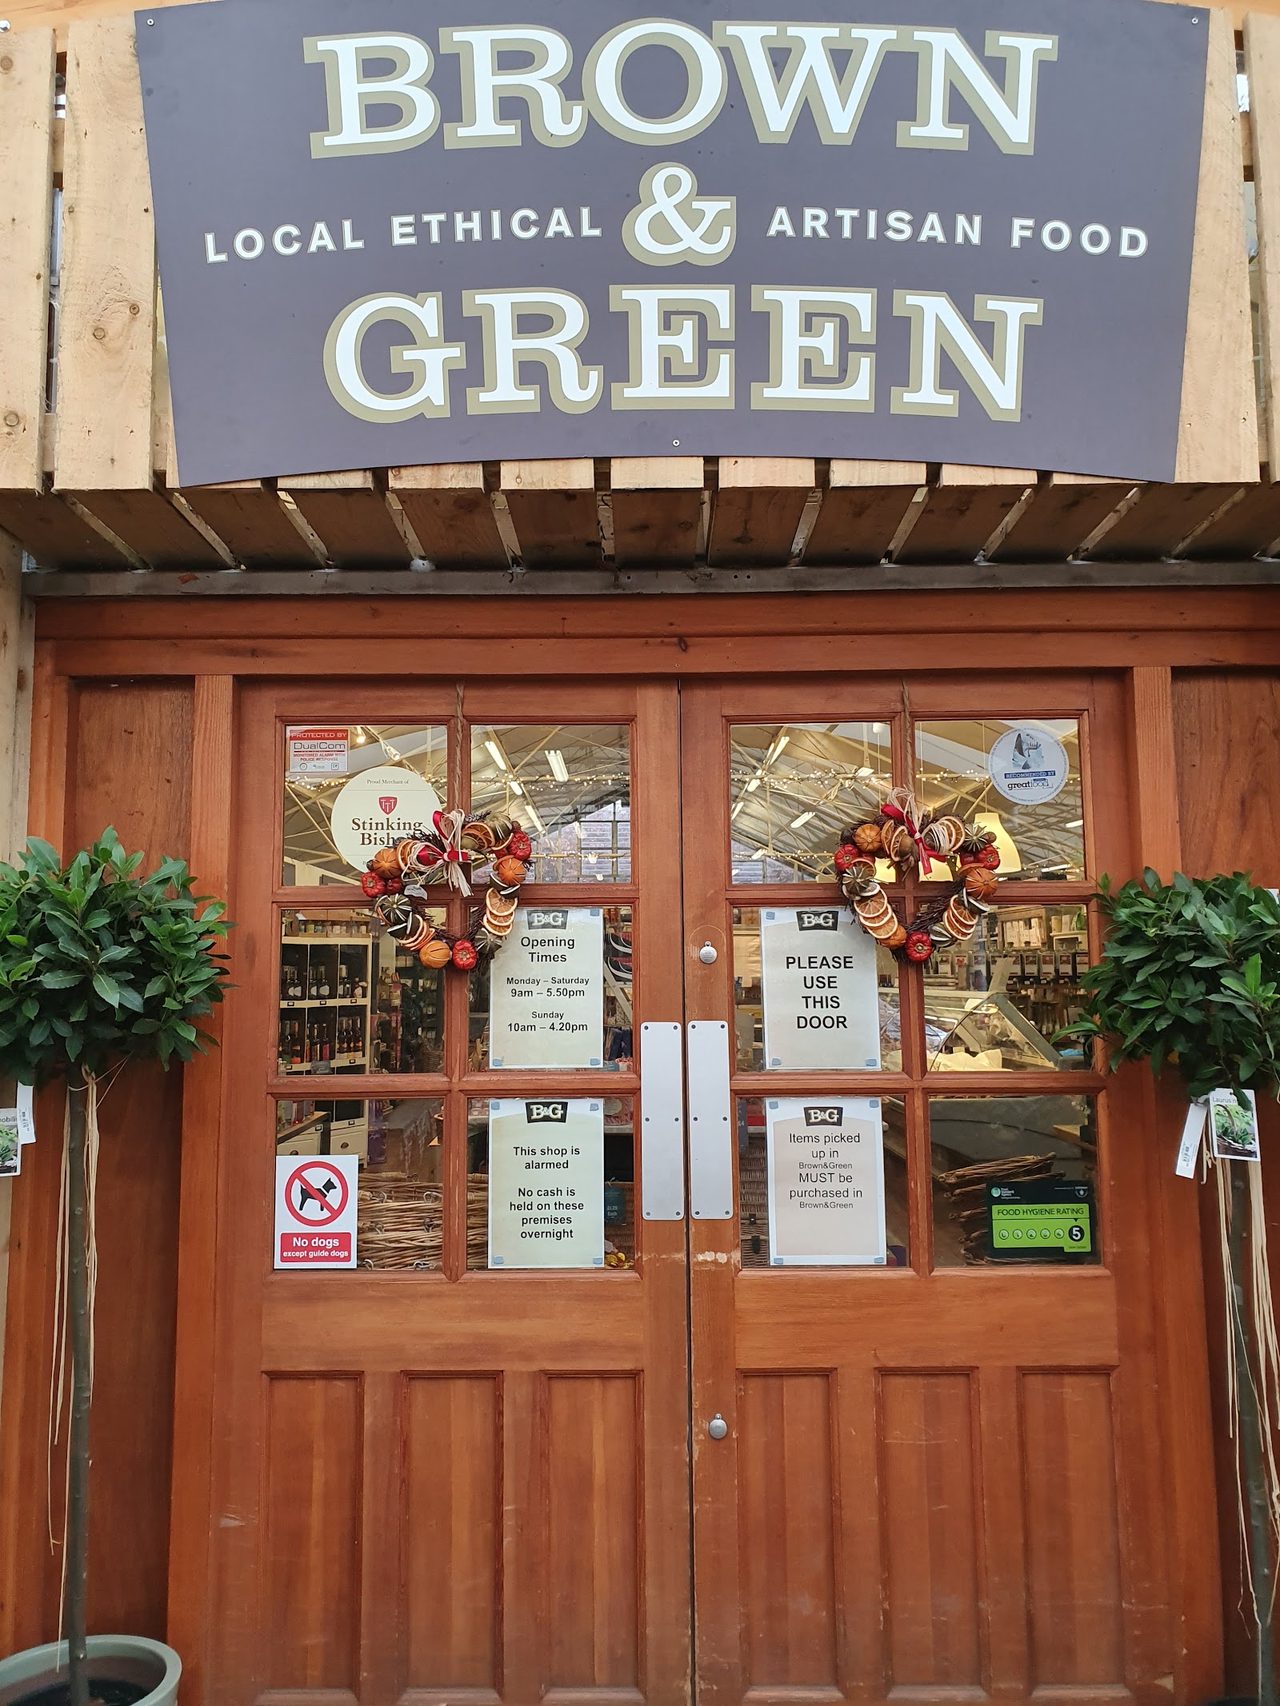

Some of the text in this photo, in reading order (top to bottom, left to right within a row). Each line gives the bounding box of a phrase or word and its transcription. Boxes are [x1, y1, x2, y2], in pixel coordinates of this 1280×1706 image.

[303, 17, 1058, 159] BROWN
[622, 162, 736, 266] &
[205, 206, 602, 263] LOCAL ETHICAL
[766, 206, 1148, 258] ARTISAN FOOD
[323, 284, 1043, 423] GREEN
[293, 742, 346, 750] DualCom
[351, 817, 423, 833] Stinking
[360, 832, 396, 846] Bish
[531, 912, 564, 927] B&G
[801, 913, 835, 928] B&G
[520, 936, 575, 950] Opening
[528, 952, 567, 963] Times
[786, 956, 854, 969] PLEASE
[506, 977, 541, 986] Monday
[551, 976, 590, 985] Saturday
[803, 976, 838, 989] USE
[510, 988, 534, 998] 9am
[546, 988, 585, 999] 5.50pm
[801, 995, 841, 1009] THIS
[531, 1011, 565, 1020] Sunday
[508, 1022, 537, 1032] 10am
[549, 1022, 588, 1033] 4.20pm
[797, 1016, 848, 1029] DOOR
[530, 1103, 564, 1120] B&G
[808, 1109, 840, 1122] B&G
[789, 1133, 861, 1145] Items picked
[513, 1145, 580, 1158] This shop is
[811, 1148, 839, 1159] up in
[524, 1160, 569, 1170] alarmed
[799, 1173, 853, 1183] MUST be
[518, 1187, 576, 1197] No cash is
[789, 1187, 863, 1199] purchased in
[509, 1201, 585, 1211] held on these
[997, 1207, 1085, 1216] FOOD HYGIENE RATING
[521, 1215, 573, 1227] premises
[520, 1229, 574, 1241] overnight
[1072, 1227, 1082, 1240] 5
[292, 1237, 340, 1249] No dogs
[283, 1250, 349, 1259] except guide dogs
